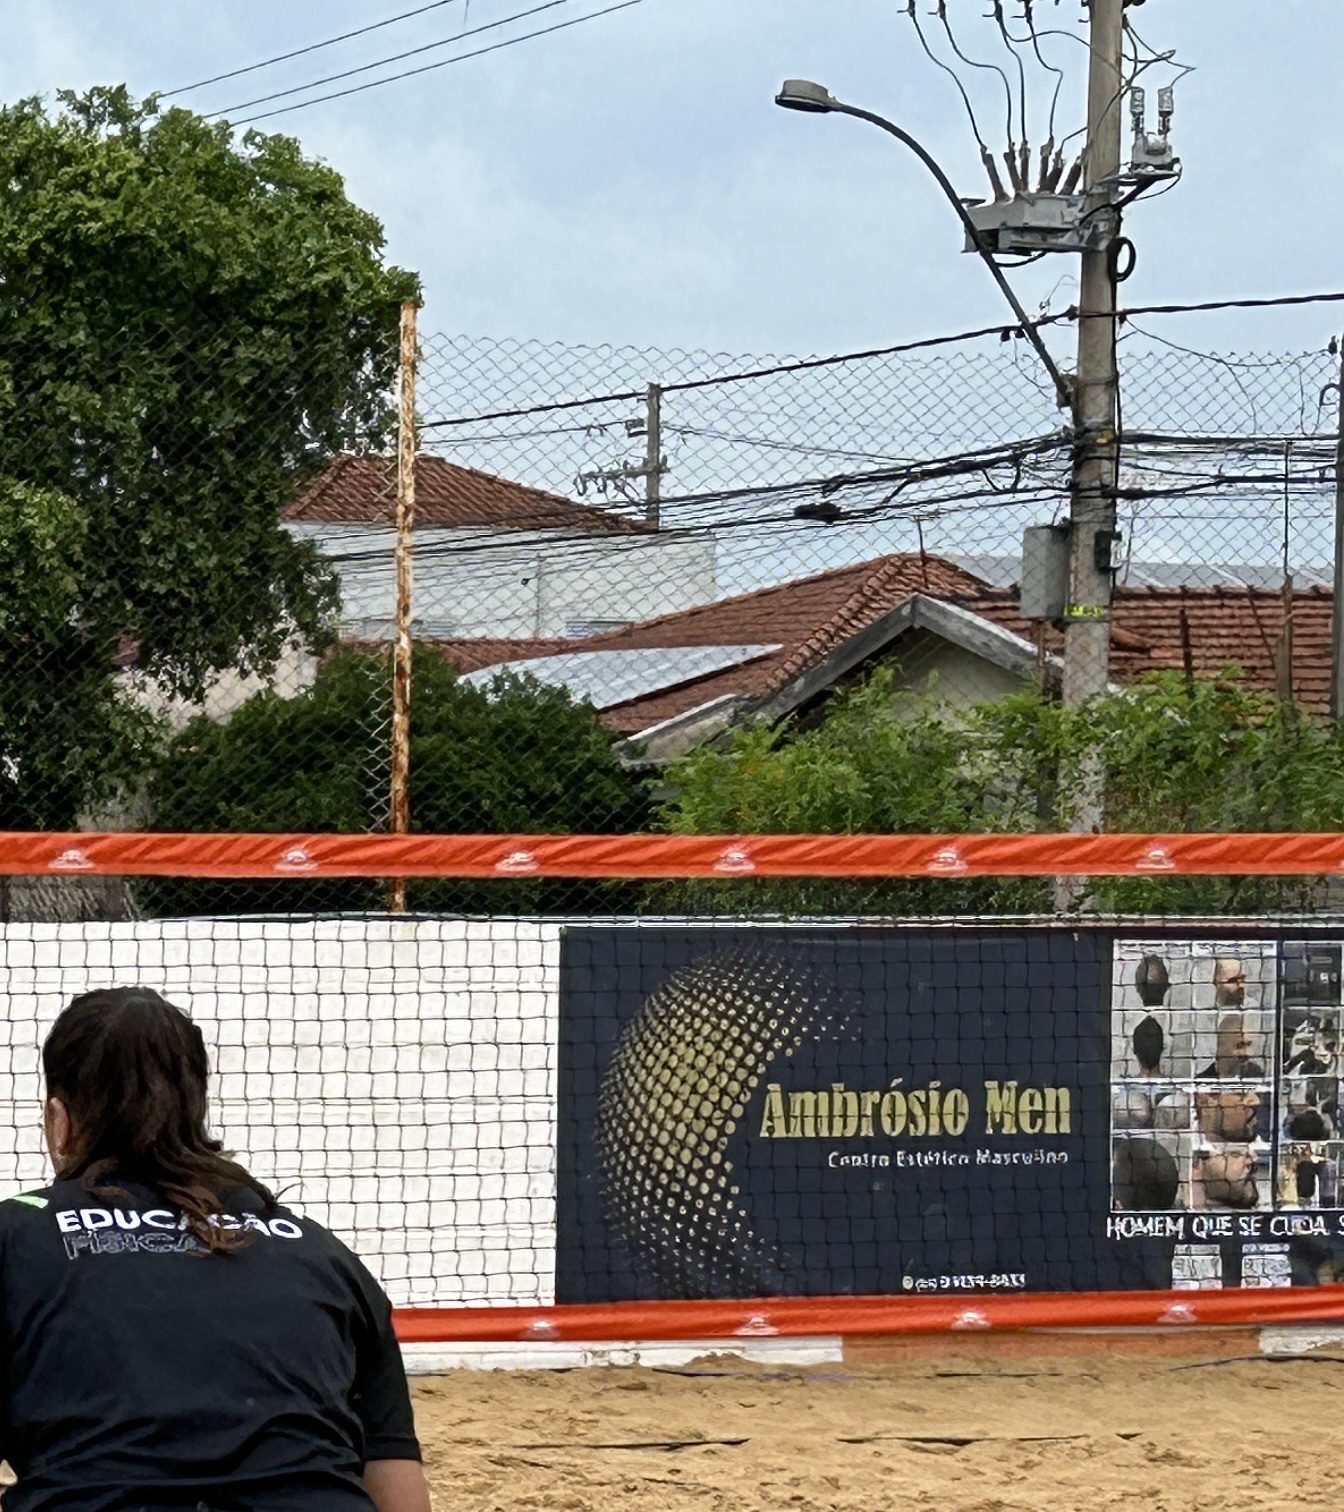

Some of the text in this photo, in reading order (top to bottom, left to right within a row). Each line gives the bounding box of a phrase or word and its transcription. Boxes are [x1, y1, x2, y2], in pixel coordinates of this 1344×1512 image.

[760, 1078, 1071, 1138] Ambrósio Men
[1106, 1215, 1185, 1241] HOMEM
[1192, 1215, 1234, 1240] QUE
[1239, 1214, 1264, 1236] SE
